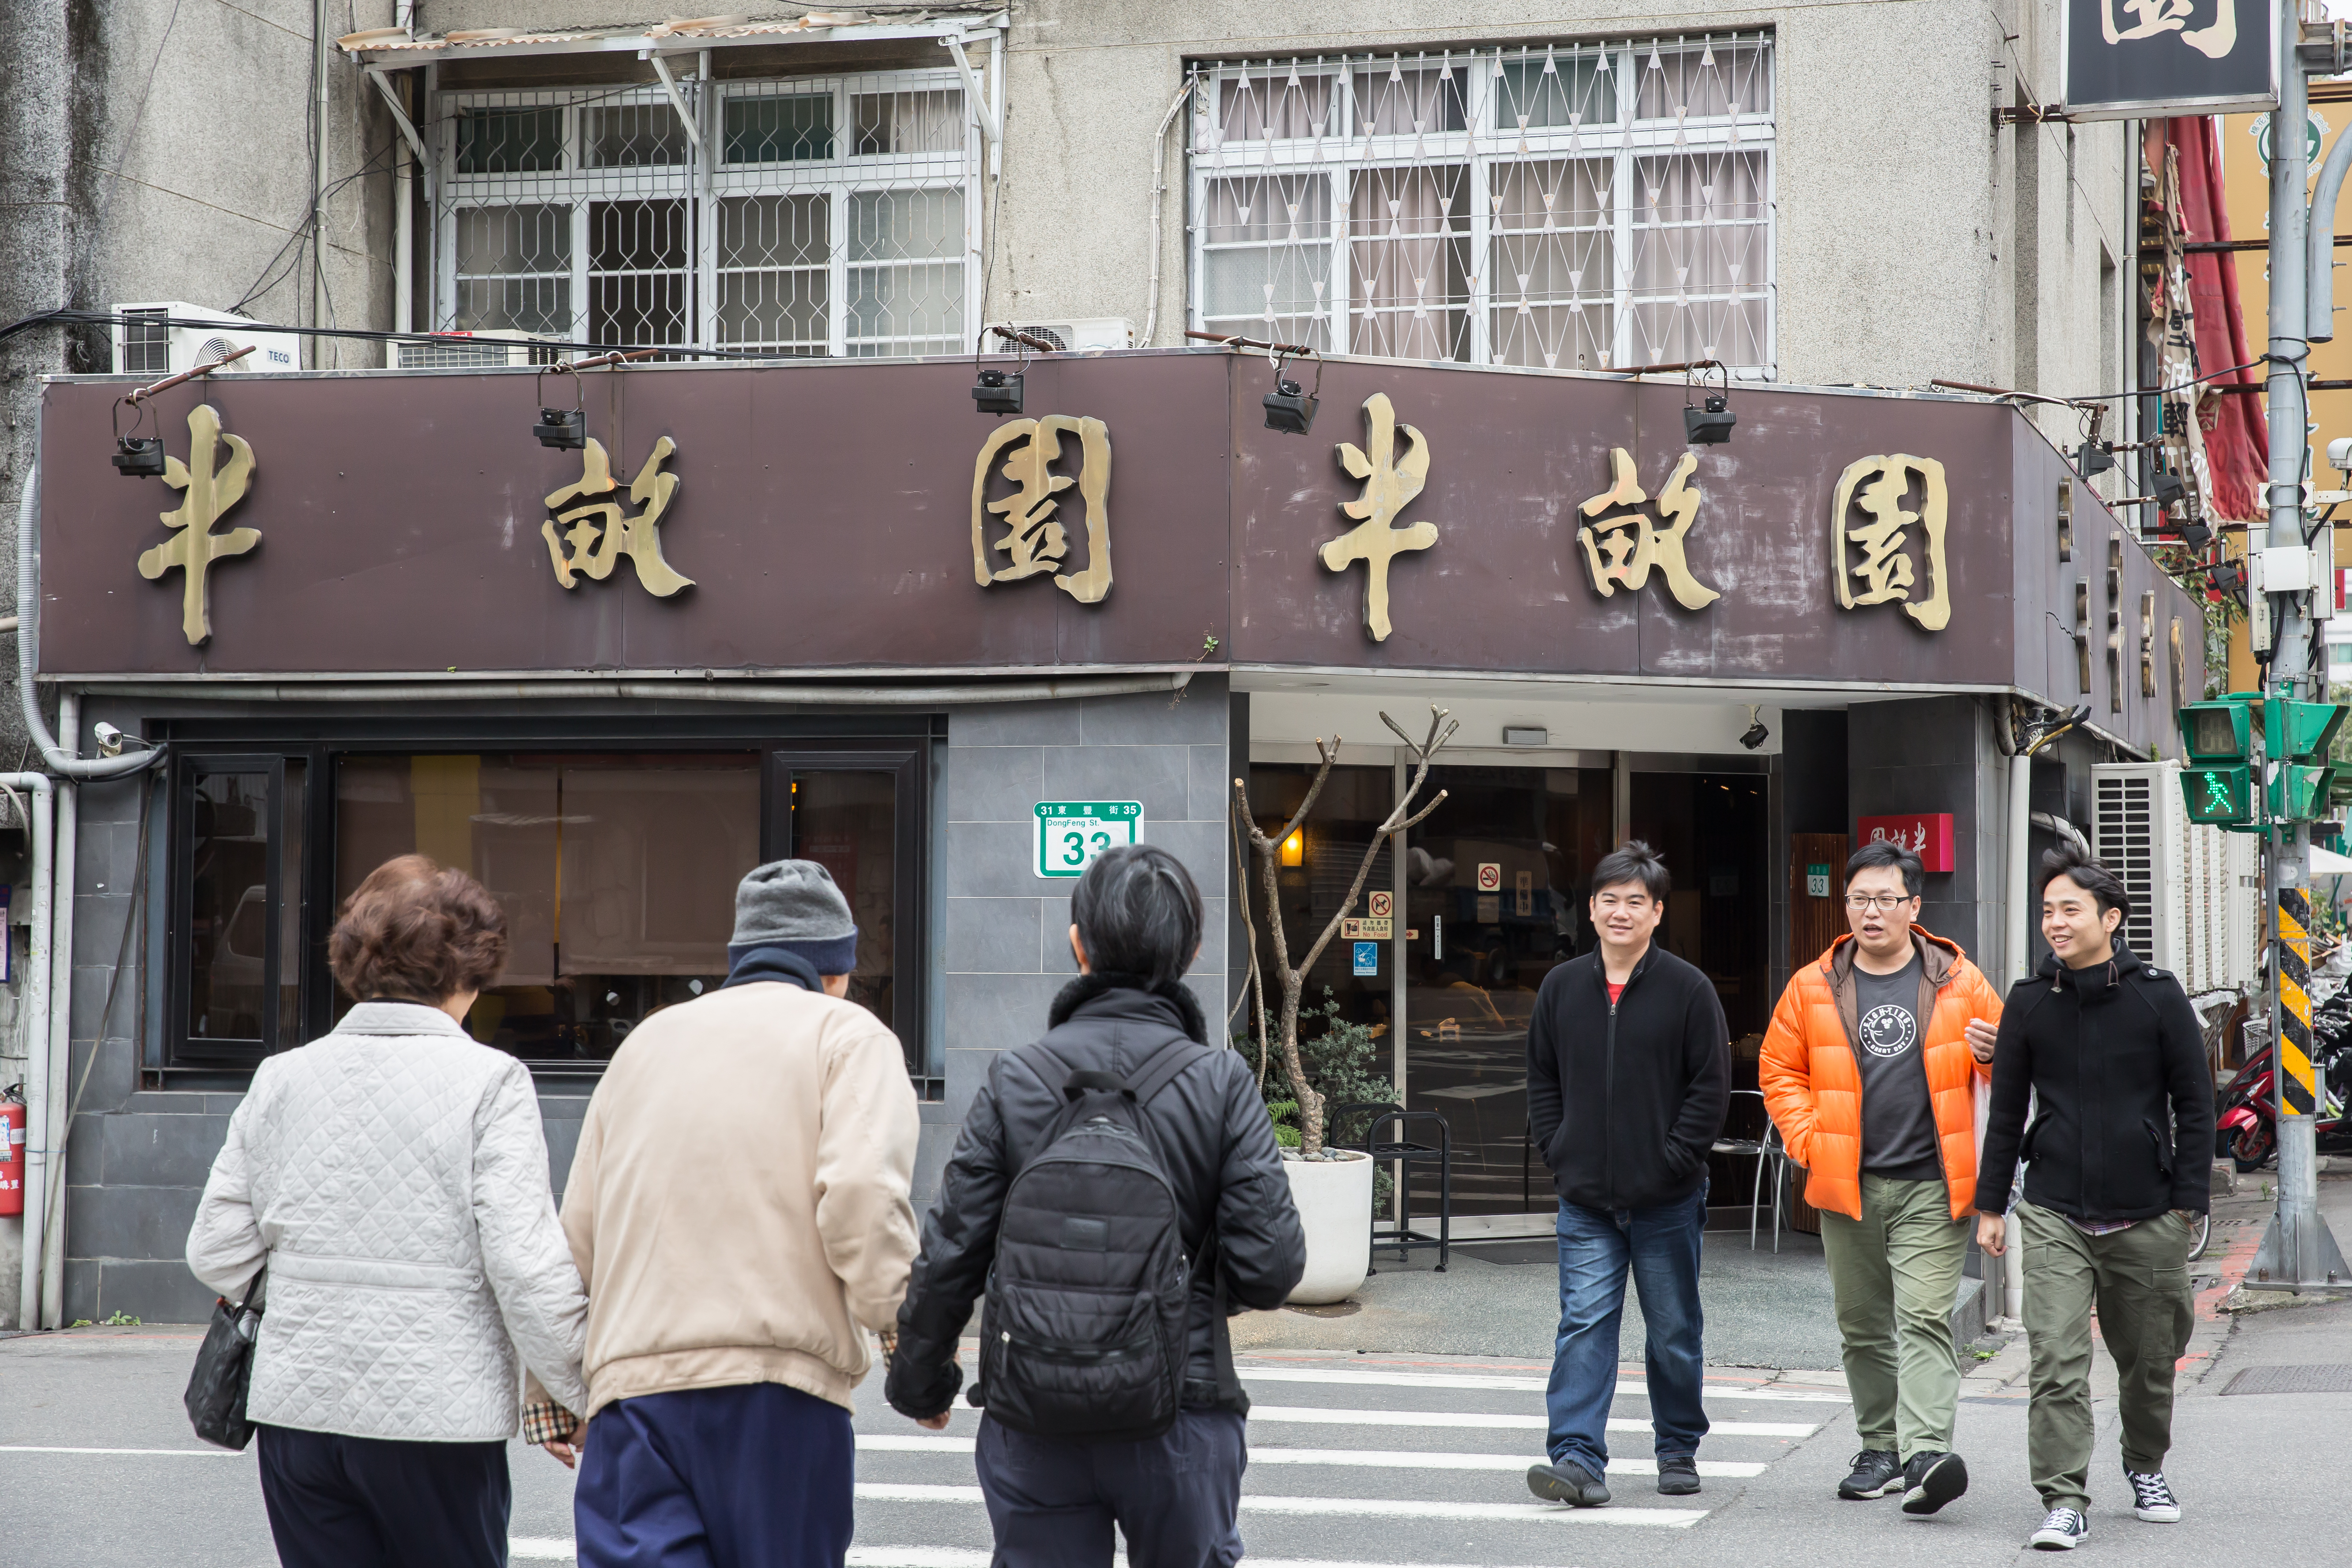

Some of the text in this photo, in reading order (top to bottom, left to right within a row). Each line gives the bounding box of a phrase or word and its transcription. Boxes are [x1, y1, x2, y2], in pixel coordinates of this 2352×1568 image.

[268, 351, 289, 363] TECO
[1040, 805, 1137, 815] 31 東豐街 35
[1047, 819, 1086, 828] DongFeng
[1063, 832, 1111, 866] 33
[1811, 878, 1824, 893] 33
[1870, 1040, 1906, 1054] GREAT DAY
